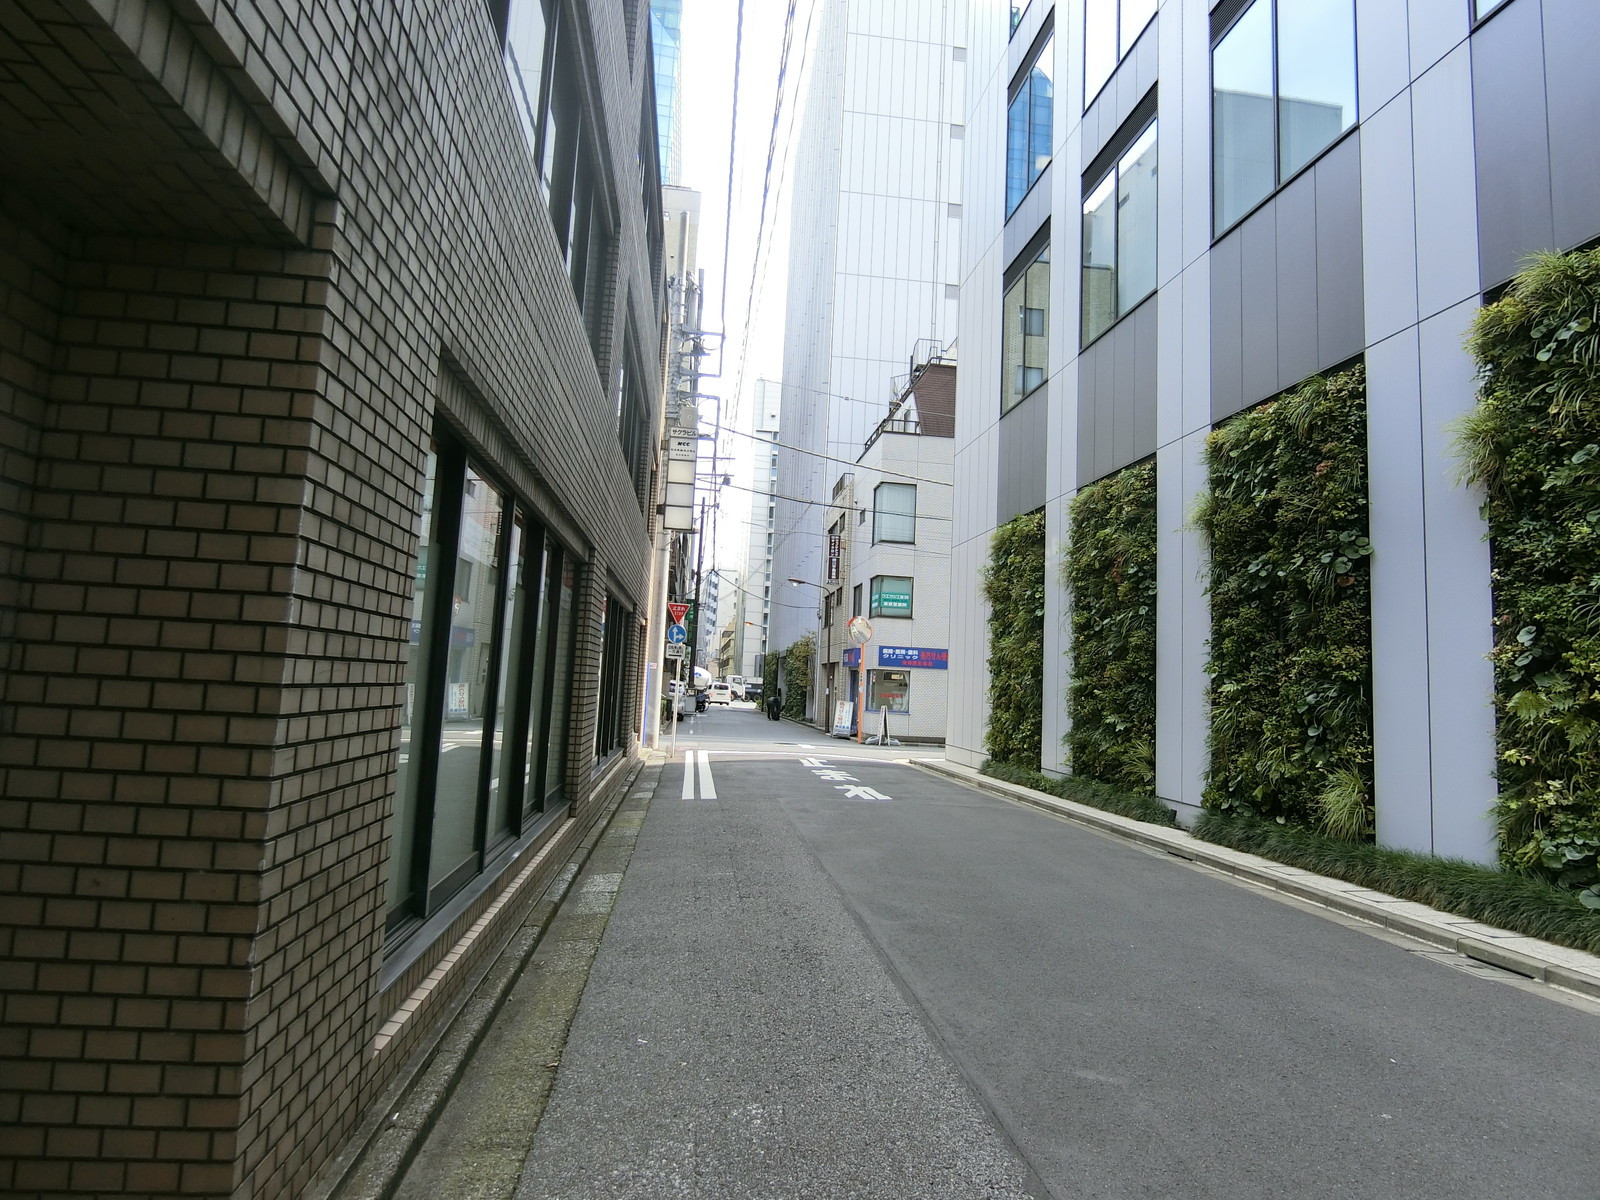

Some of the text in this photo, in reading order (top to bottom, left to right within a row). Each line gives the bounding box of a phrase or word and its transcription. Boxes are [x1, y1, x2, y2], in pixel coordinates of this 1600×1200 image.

[672, 429, 697, 437] サクラビル
[798, 757, 894, 800] 止まれ
